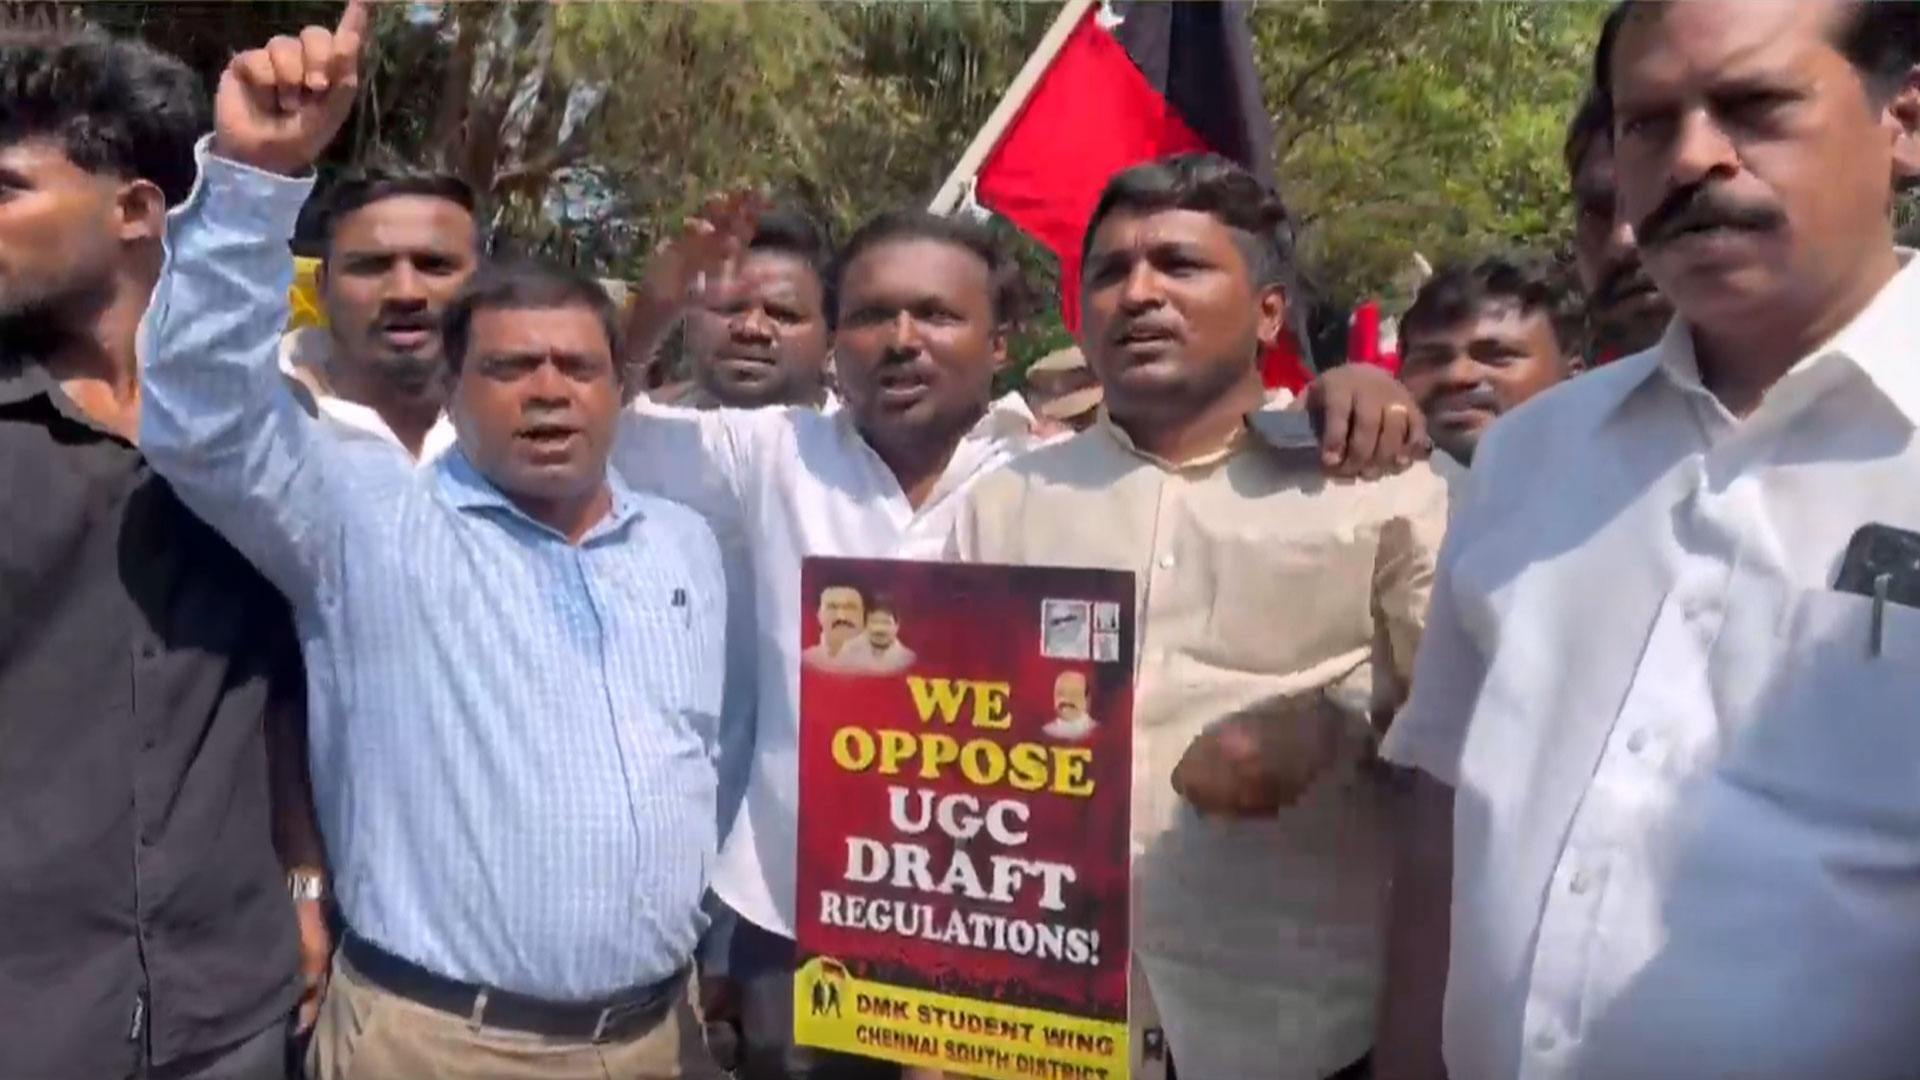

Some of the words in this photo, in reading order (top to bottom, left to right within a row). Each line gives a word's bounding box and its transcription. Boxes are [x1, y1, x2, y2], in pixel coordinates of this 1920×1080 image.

[906, 675, 1012, 729] WE
[831, 726, 1095, 796] OPPOSE
[887, 785, 1030, 845] UGC
[844, 836, 1076, 911] DRAFT
[819, 890, 1100, 965] REGULATIONS!
[856, 1024, 938, 1056] CHENNAI
[944, 1039, 1009, 1071] SOUTH
[857, 993, 909, 1020] DMK
[917, 1004, 1034, 1043] STUDENT
[1043, 1025, 1114, 1056] WING
